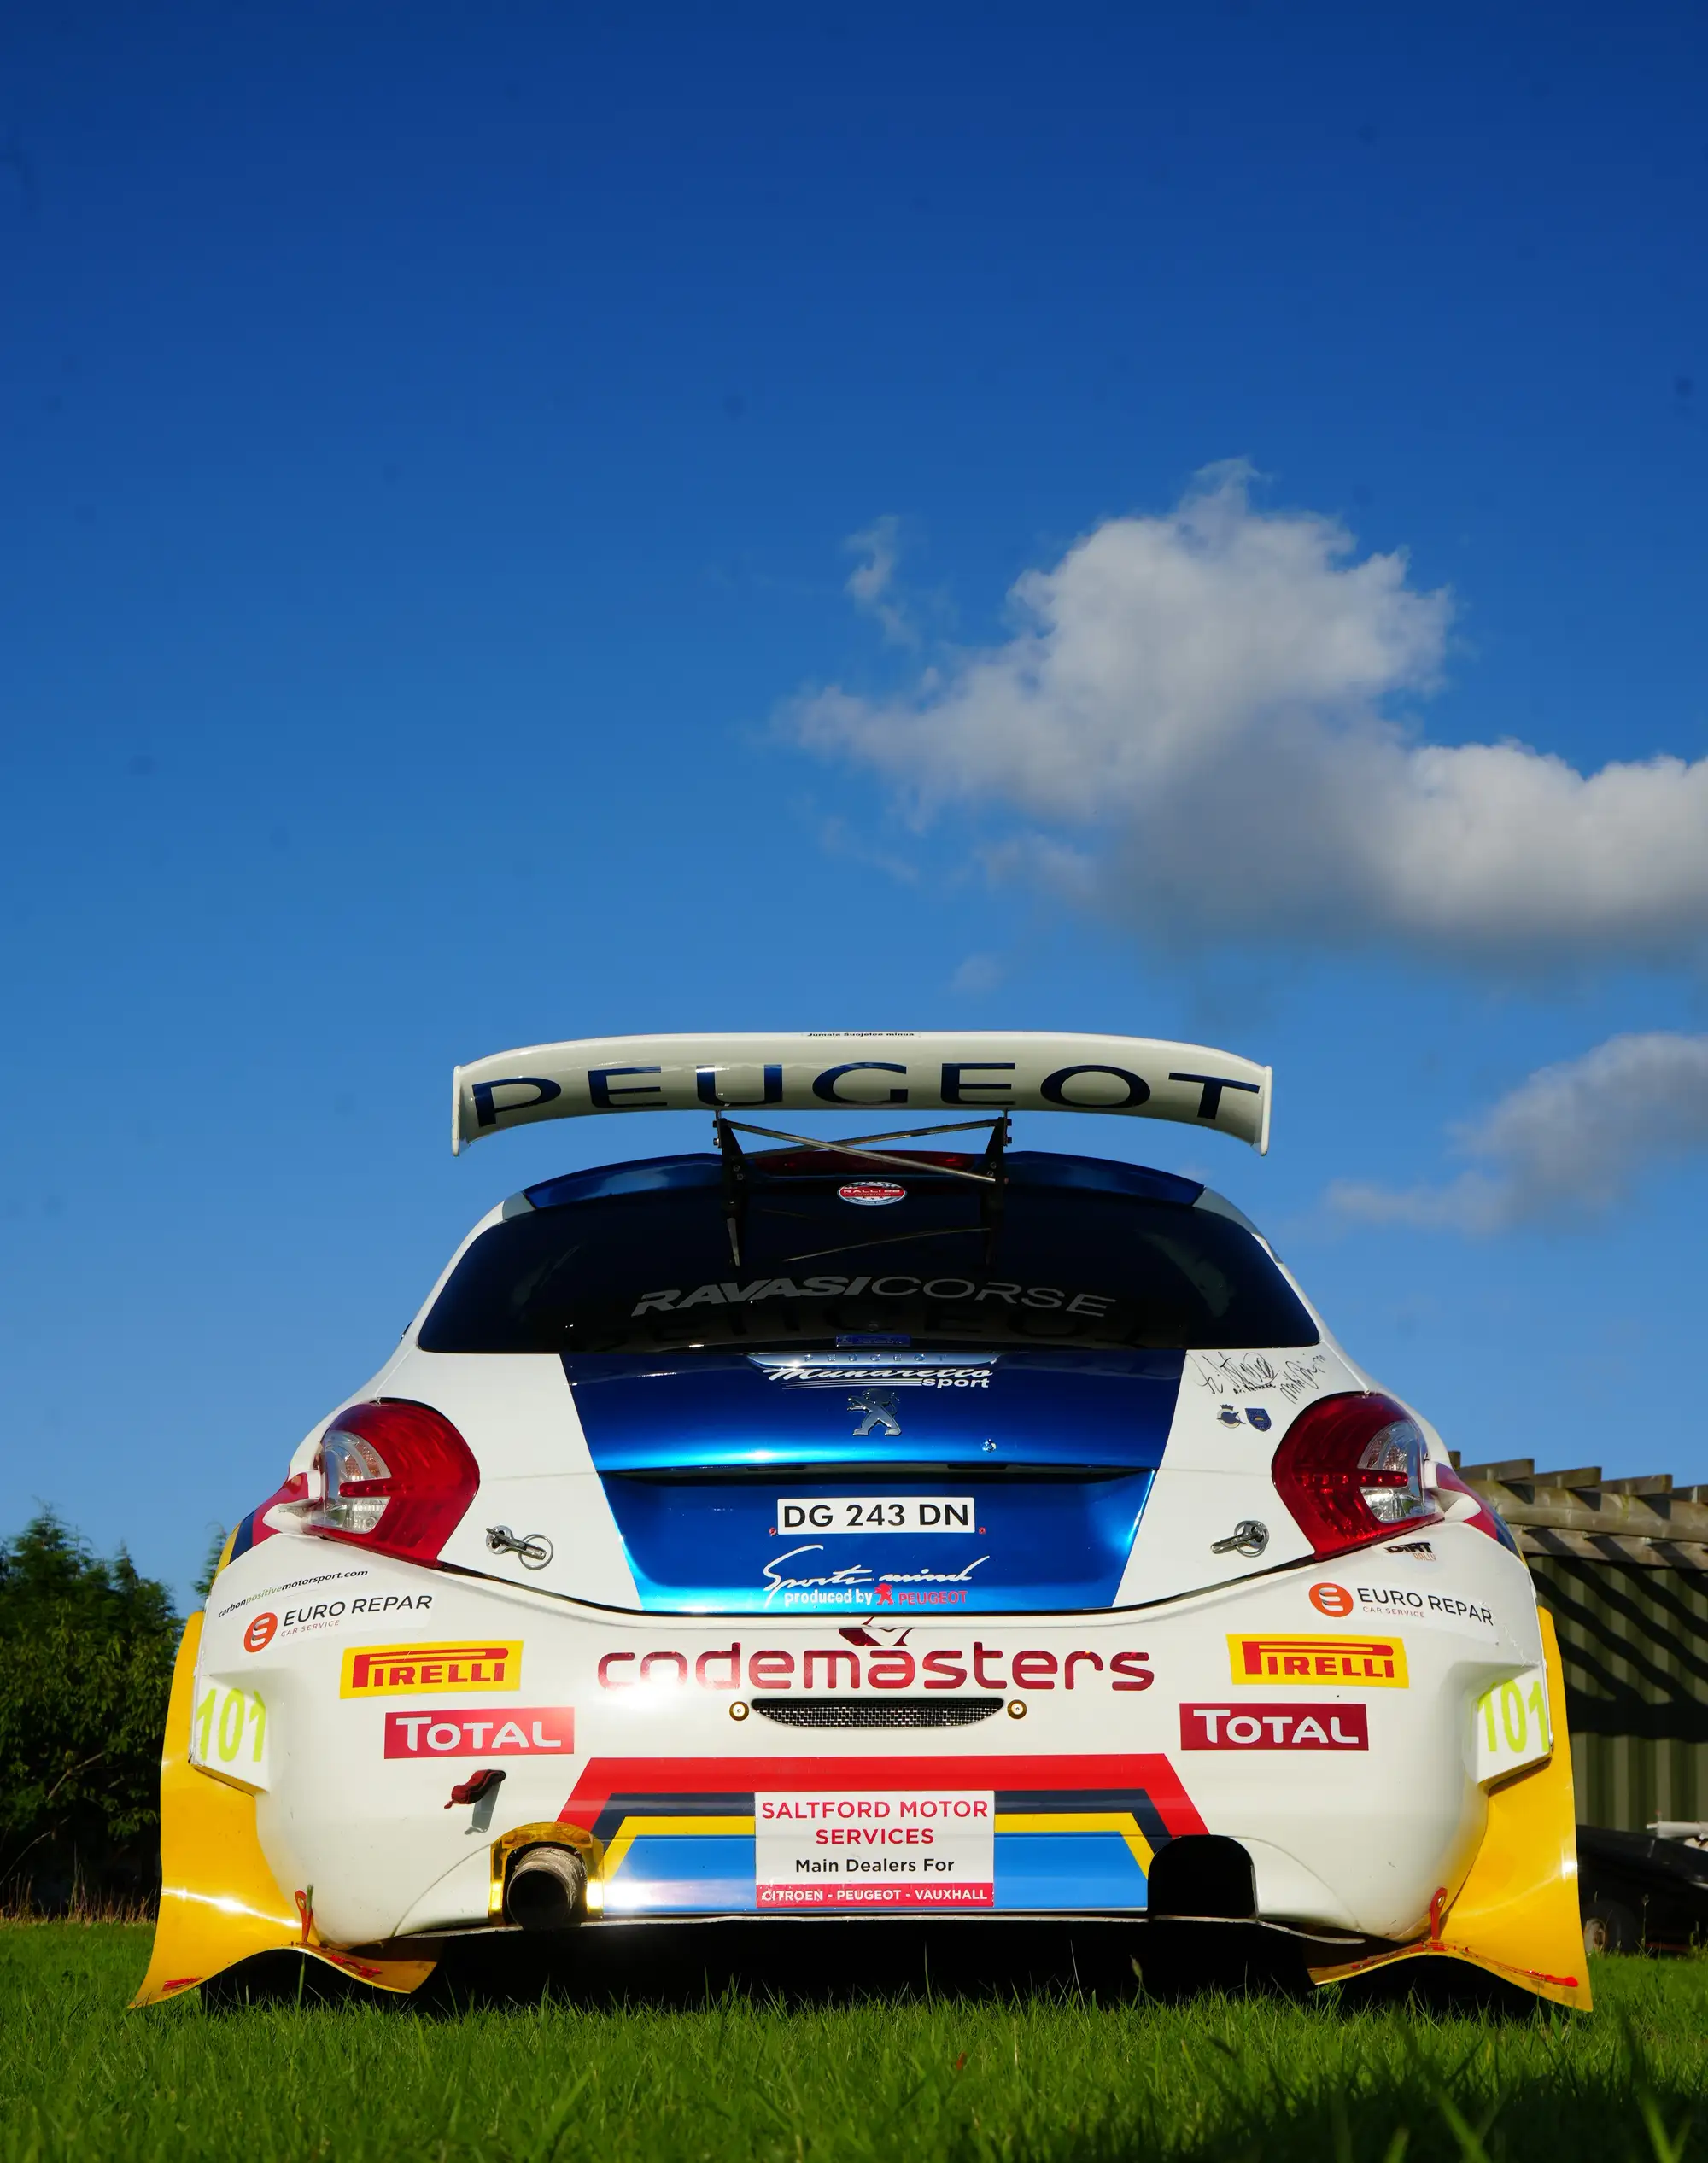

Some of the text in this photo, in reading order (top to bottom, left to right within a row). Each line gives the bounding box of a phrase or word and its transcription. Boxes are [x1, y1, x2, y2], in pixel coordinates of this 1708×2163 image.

[471, 1062, 1261, 1127] PEUGEOT
[631, 1276, 1117, 1317] RAVASICORSE
[921, 1377, 991, 1389] sport
[783, 1504, 969, 1528] DG 243 DN
[218, 1569, 368, 1618] carbonpositivemotorsport.com
[283, 1595, 433, 1627] EURO REPAR
[784, 1589, 968, 1606] produced by PEUGEOT
[1356, 1588, 1494, 1627] EURO REPAR
[280, 1620, 339, 1637] CAR SERVICE
[1362, 1606, 1425, 1618] CAR SERVICE
[352, 1647, 509, 1688] PIRELLI
[597, 1641, 1155, 1692] codemasters
[1242, 1640, 1395, 1679] PIRELLI
[196, 1687, 266, 1763] 101
[395, 1716, 562, 1751] TOTAL
[1193, 1709, 1359, 1745] TOTAL
[1477, 1679, 1550, 1753] 101
[761, 1800, 988, 1820] SALTFORD MOTOR
[815, 1828, 934, 1845] SERVICES
[795, 1856, 955, 1874] Main Dealers For
[761, 1890, 824, 1902] CITROEN
[836, 1889, 902, 1901] PEUGEOT
[914, 1889, 988, 1901] VAUXHALL
